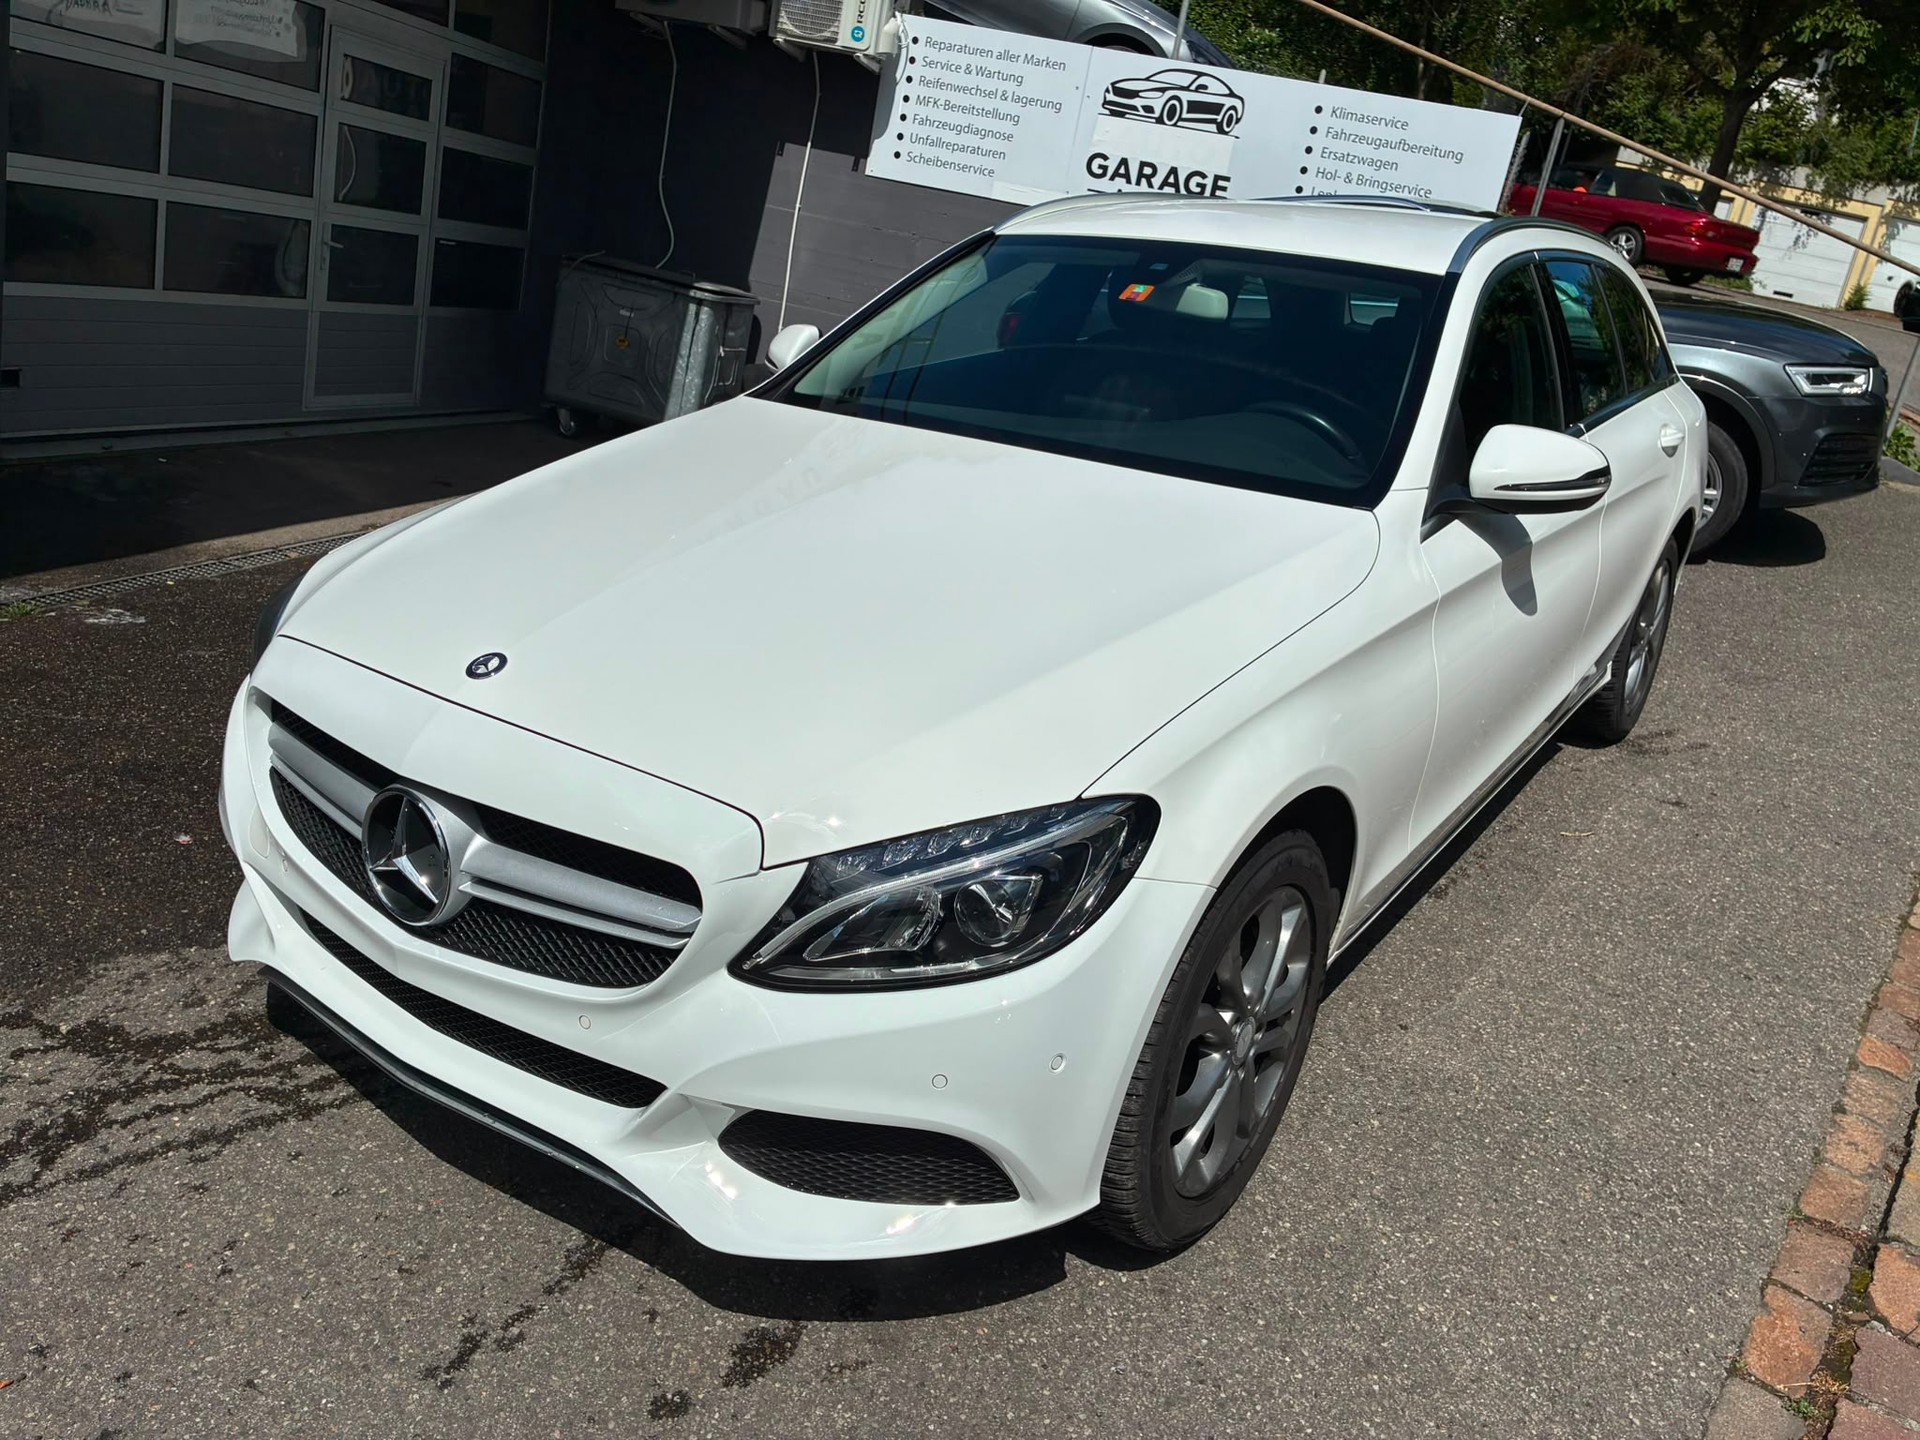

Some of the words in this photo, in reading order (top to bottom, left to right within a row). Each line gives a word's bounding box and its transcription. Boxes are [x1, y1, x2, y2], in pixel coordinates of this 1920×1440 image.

[924, 36, 993, 59] Reparaturen
[996, 49, 1021, 63] aller
[1022, 54, 1066, 71] Marken
[921, 56, 962, 74] Service
[963, 63, 973, 75] &
[974, 65, 1024, 87] Wartung
[915, 94, 1020, 126] MFK-Bereitstellung
[918, 75, 998, 100] Reifenwechsel
[1000, 89, 1009, 101] &
[1010, 92, 1062, 114] lagerung
[911, 113, 1014, 142] Fahrzeugdiagnose
[1329, 105, 1409, 131] Klimaservice
[909, 132, 1006, 160] Unfallreparaturen
[1320, 147, 1399, 172] Ersatzwagen
[1325, 126, 1464, 164] Fahrzeugaufbereitung
[906, 151, 995, 178] Scheibenservice
[1086, 152, 1231, 199] GARAGE
[1315, 166, 1342, 182] Hol-
[1343, 172, 1354, 185] &
[1355, 173, 1432, 199] Bringservice
